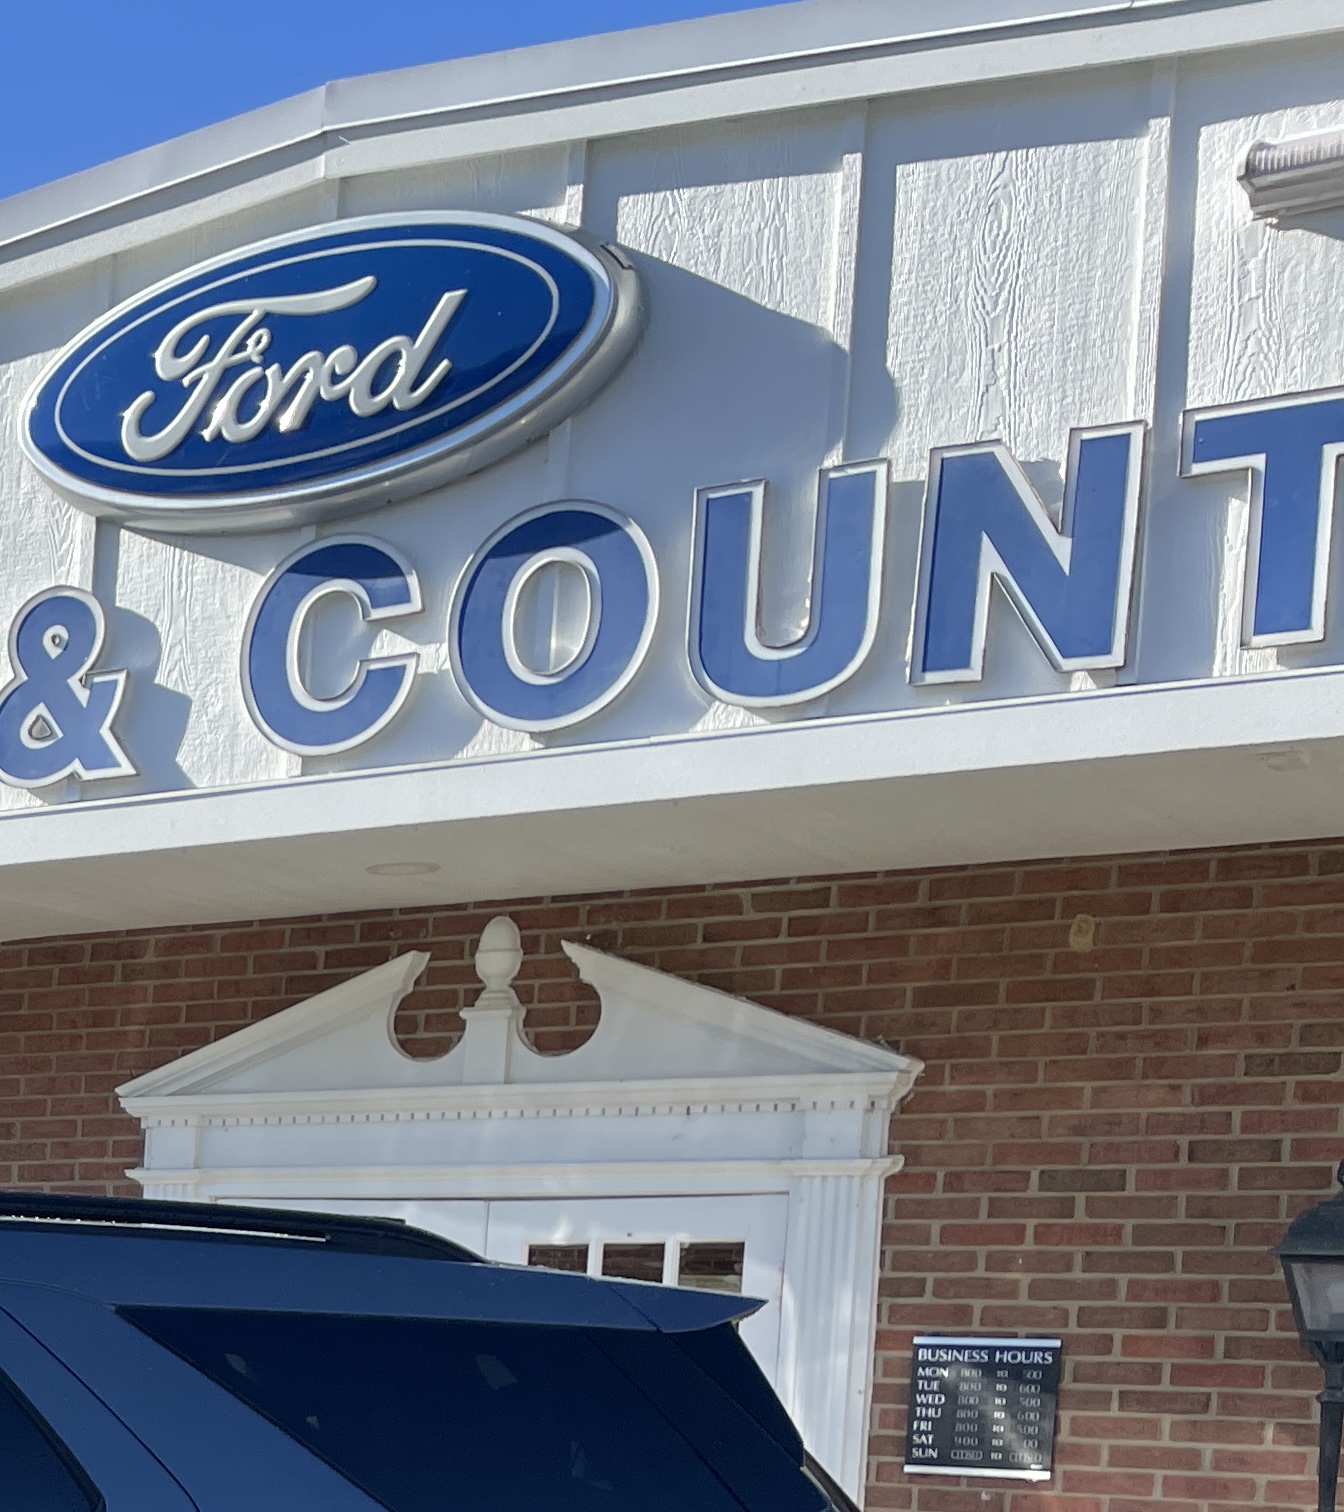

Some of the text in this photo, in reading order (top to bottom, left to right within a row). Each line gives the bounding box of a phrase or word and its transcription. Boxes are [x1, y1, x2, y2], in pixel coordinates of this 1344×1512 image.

[119, 275, 469, 463] Ford
[917, 1348, 1053, 1364] BUSINESS HOURS
[917, 1366, 949, 1378] MON
[917, 1380, 940, 1391] TUE
[915, 1394, 946, 1405] WED
[915, 1407, 941, 1418] THU
[913, 1421, 932, 1432] FRI
[912, 1434, 934, 1445] SAT
[912, 1447, 938, 1459] SUN
